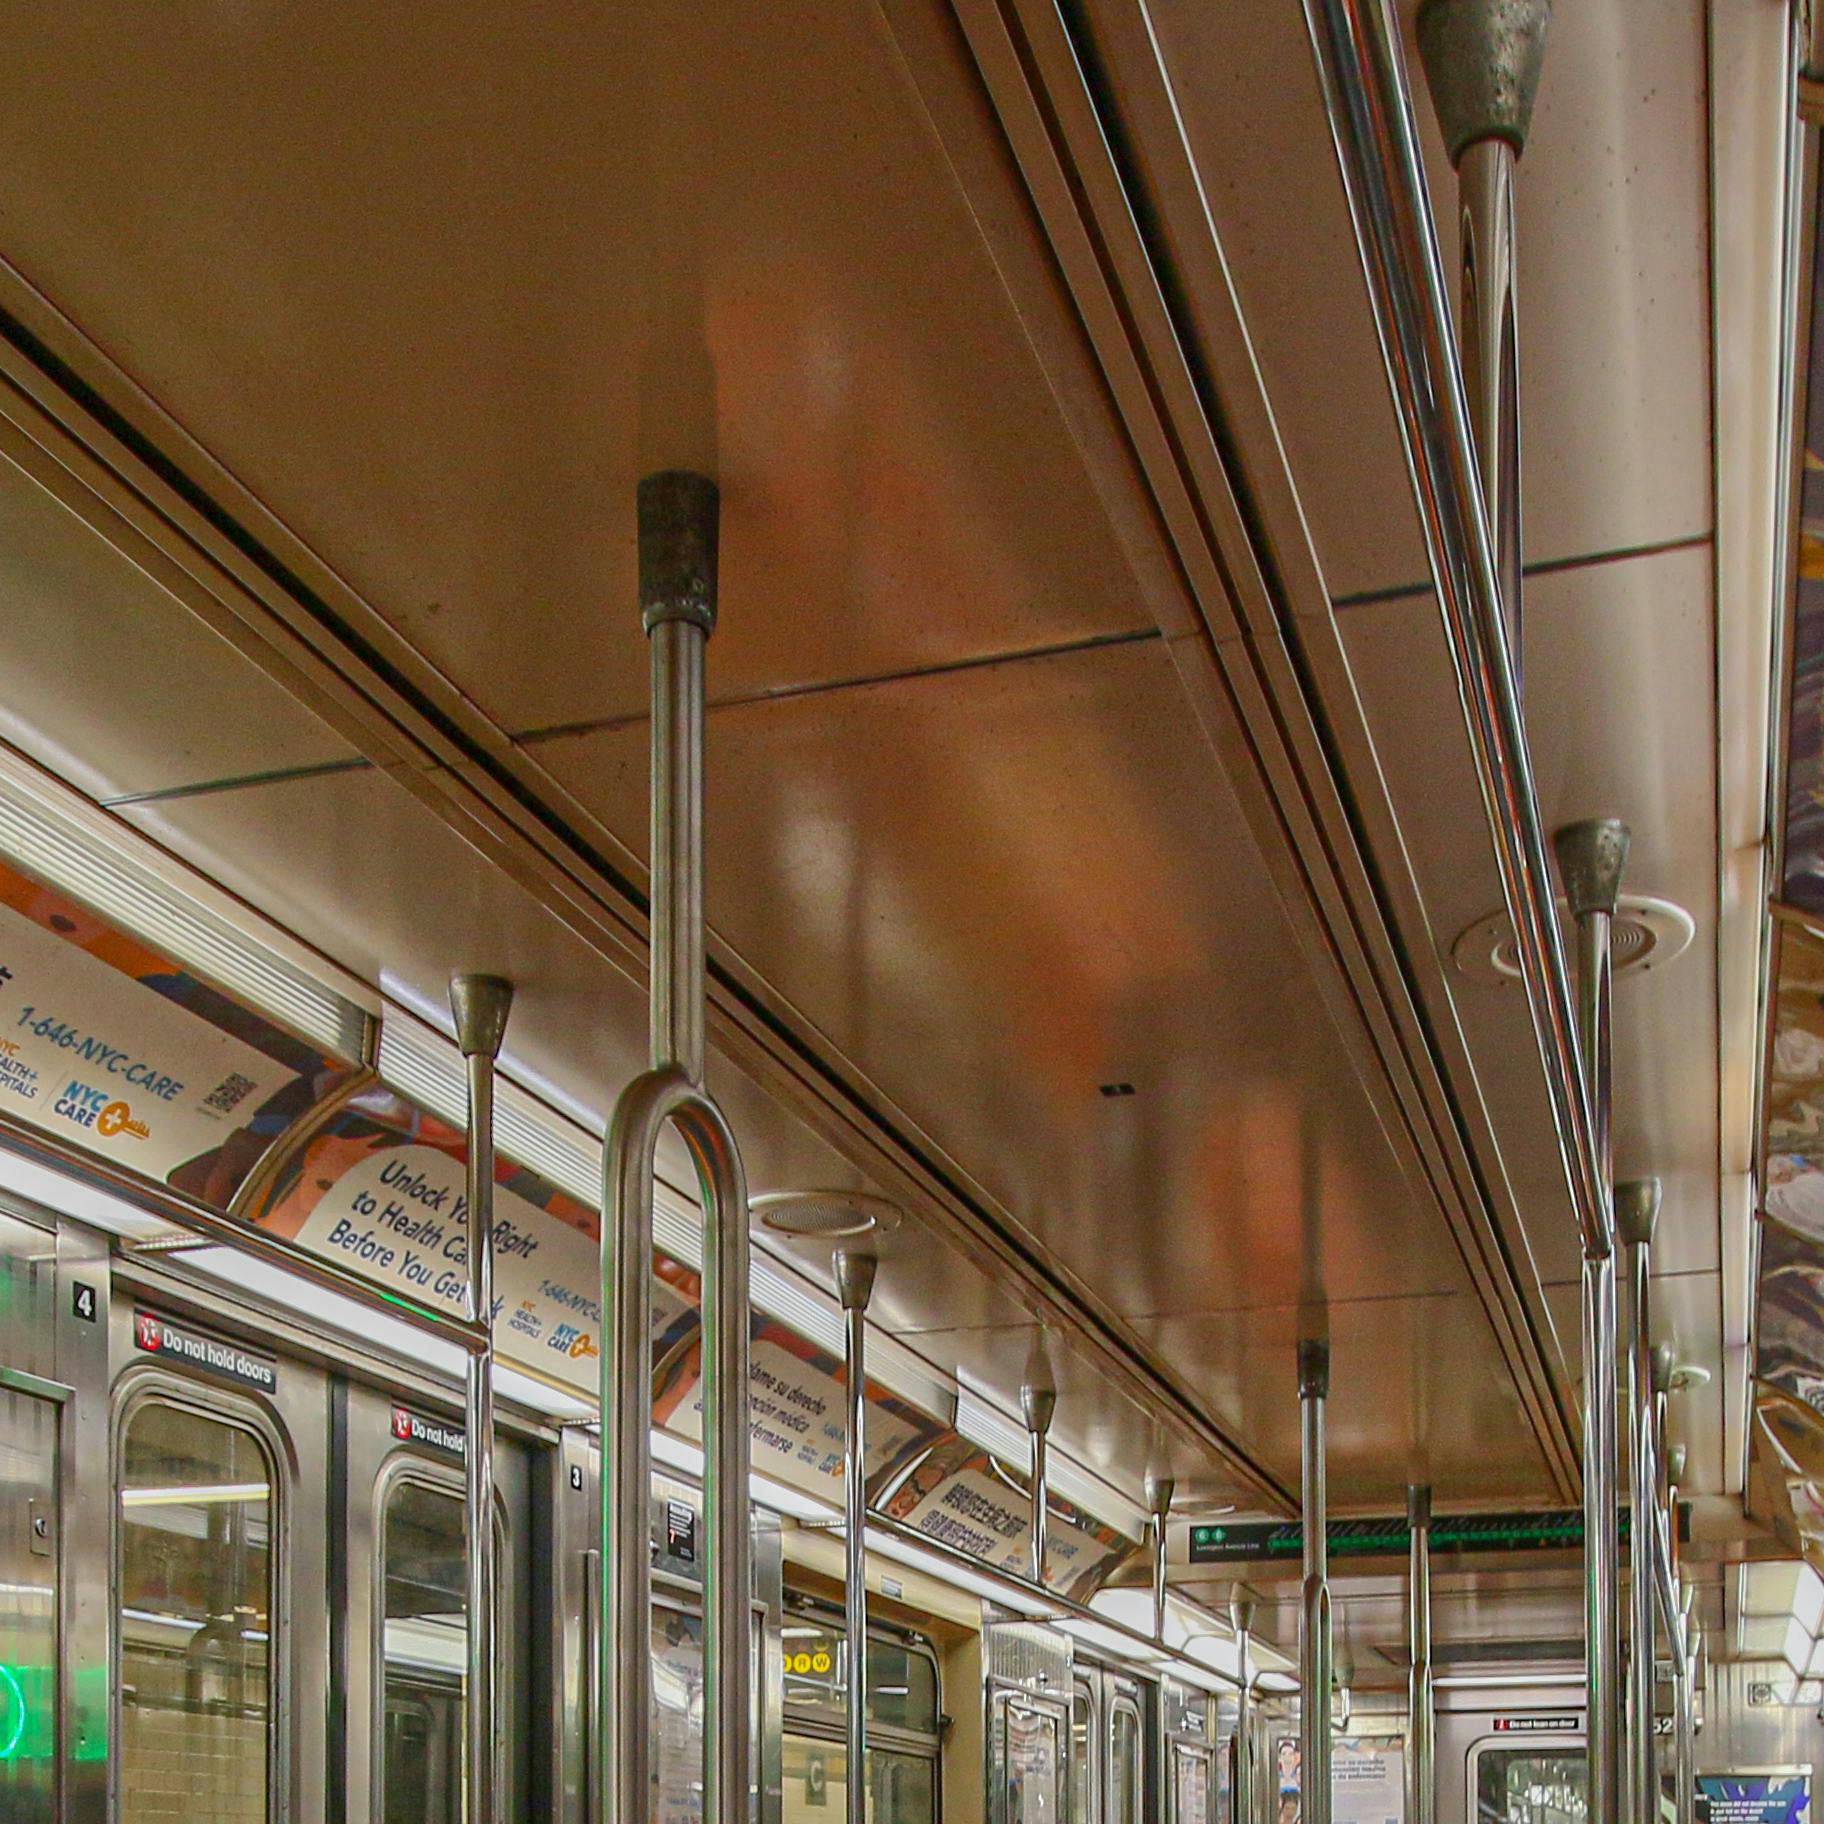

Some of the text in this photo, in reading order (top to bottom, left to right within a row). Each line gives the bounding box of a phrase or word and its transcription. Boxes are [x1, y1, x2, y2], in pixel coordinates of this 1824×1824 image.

[17, 1006, 185, 1101] 1-646-NYC-CARE
[53, 1099, 97, 1128] CARE
[63, 1080, 109, 1113] NYC
[351, 1190, 377, 1216] to
[377, 1201, 443, 1251] Health
[380, 1160, 450, 1212] Unlock
[493, 1220, 539, 1260] Right
[327, 1218, 466, 1304] Before You Get
[78, 1290, 92, 1317] 4
[163, 1328, 272, 1384] Do not hold doors
[412, 1418, 464, 1452] Do not hold
[572, 1467, 581, 1488] 3
[816, 1657, 827, 1667] W
